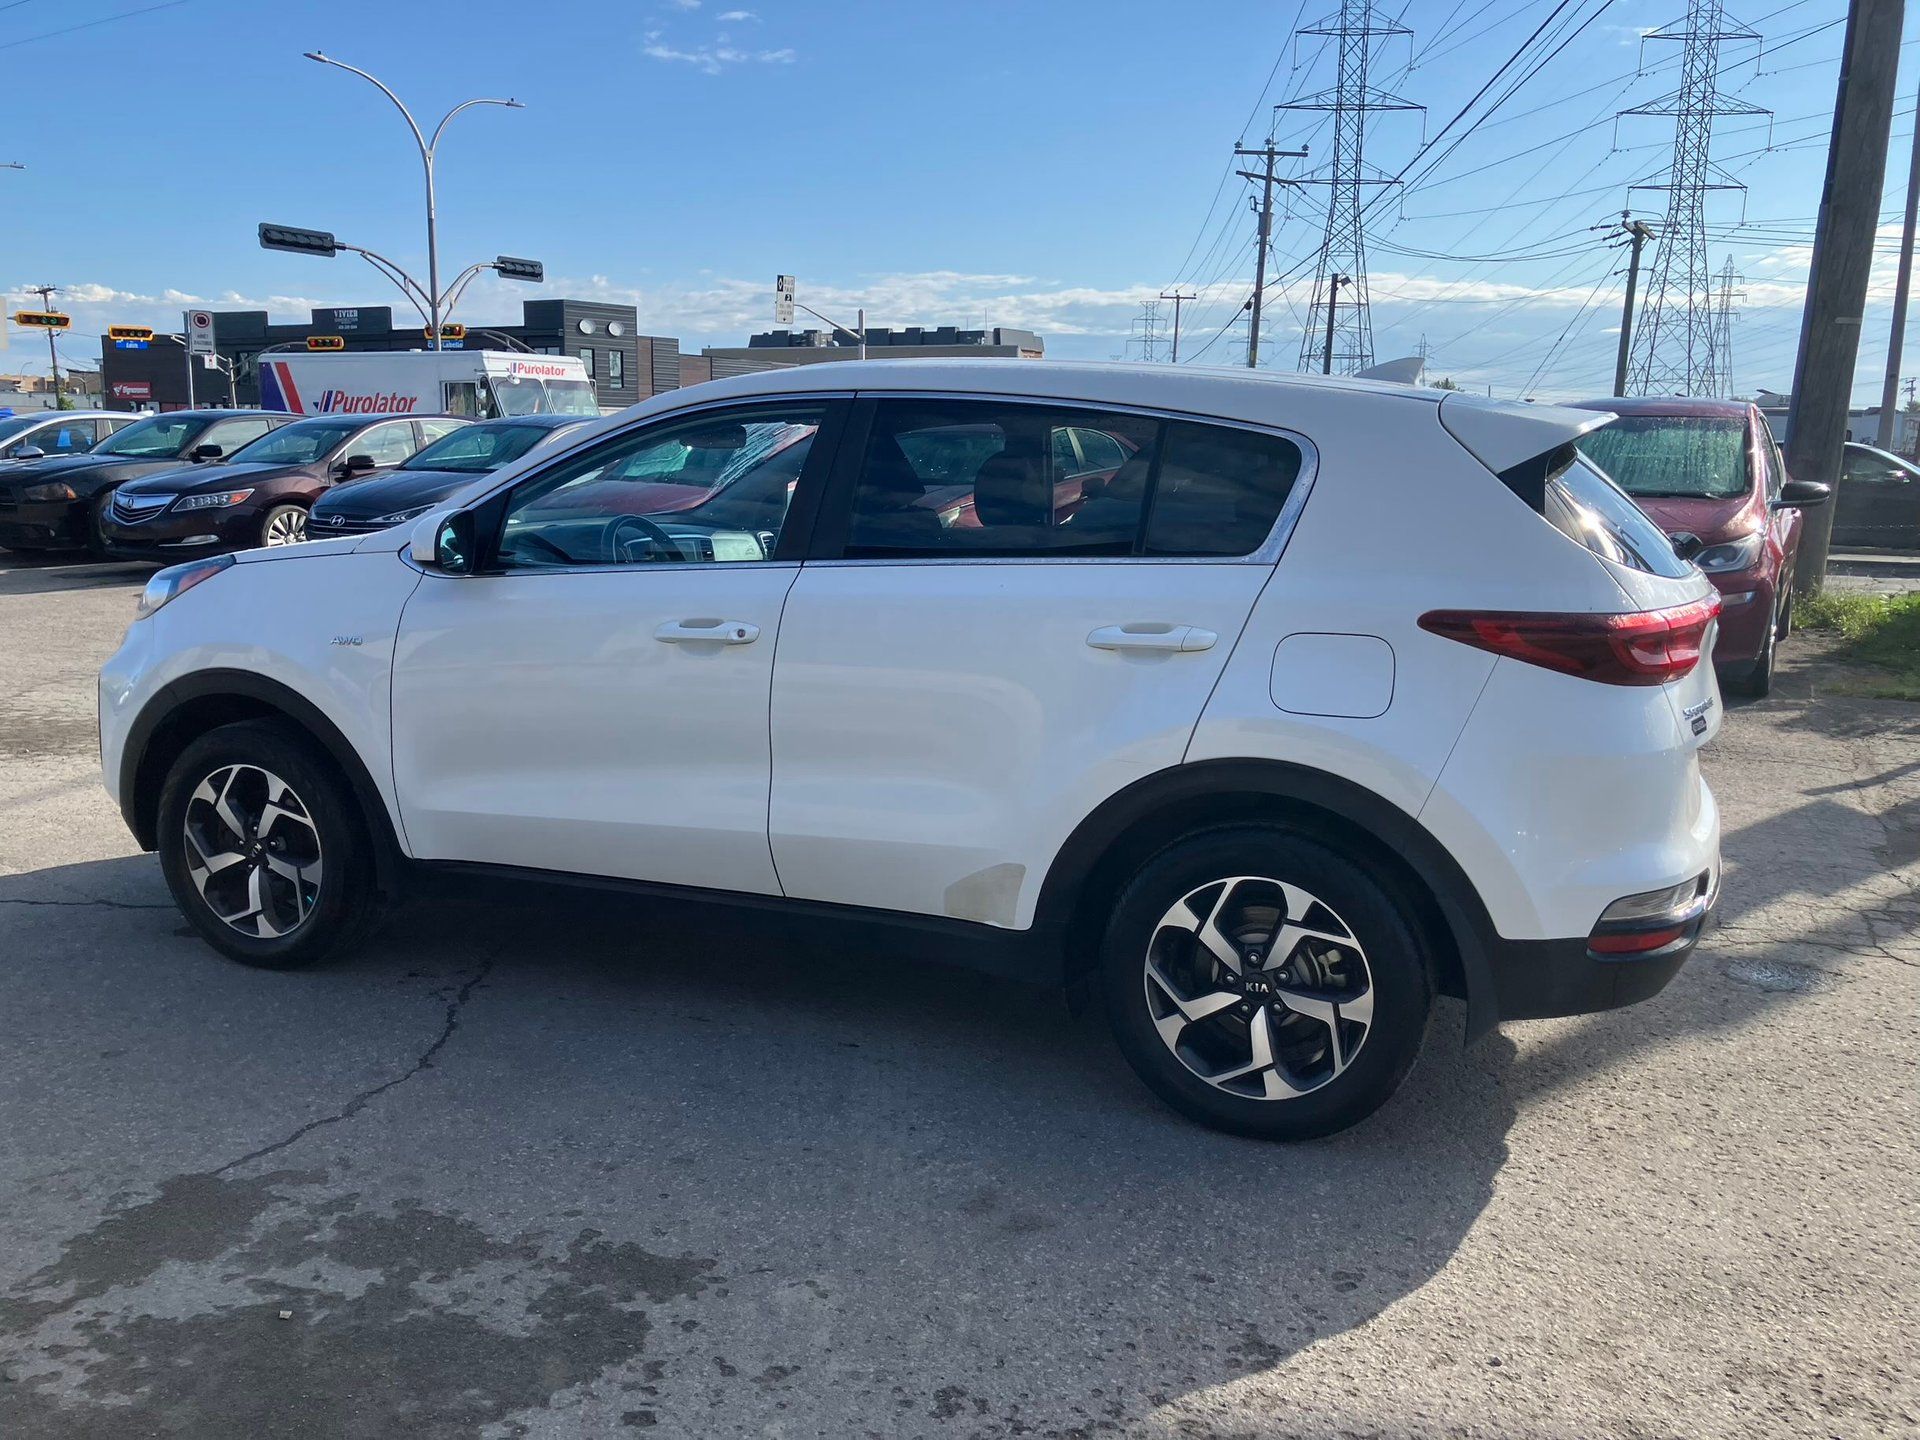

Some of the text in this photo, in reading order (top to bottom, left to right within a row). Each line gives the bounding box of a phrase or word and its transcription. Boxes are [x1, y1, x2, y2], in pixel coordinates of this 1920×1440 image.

[333, 310, 358, 318] VIVIER
[517, 362, 566, 376] Purolator
[331, 390, 418, 413] Purolator
[1245, 982, 1270, 993] KIA
